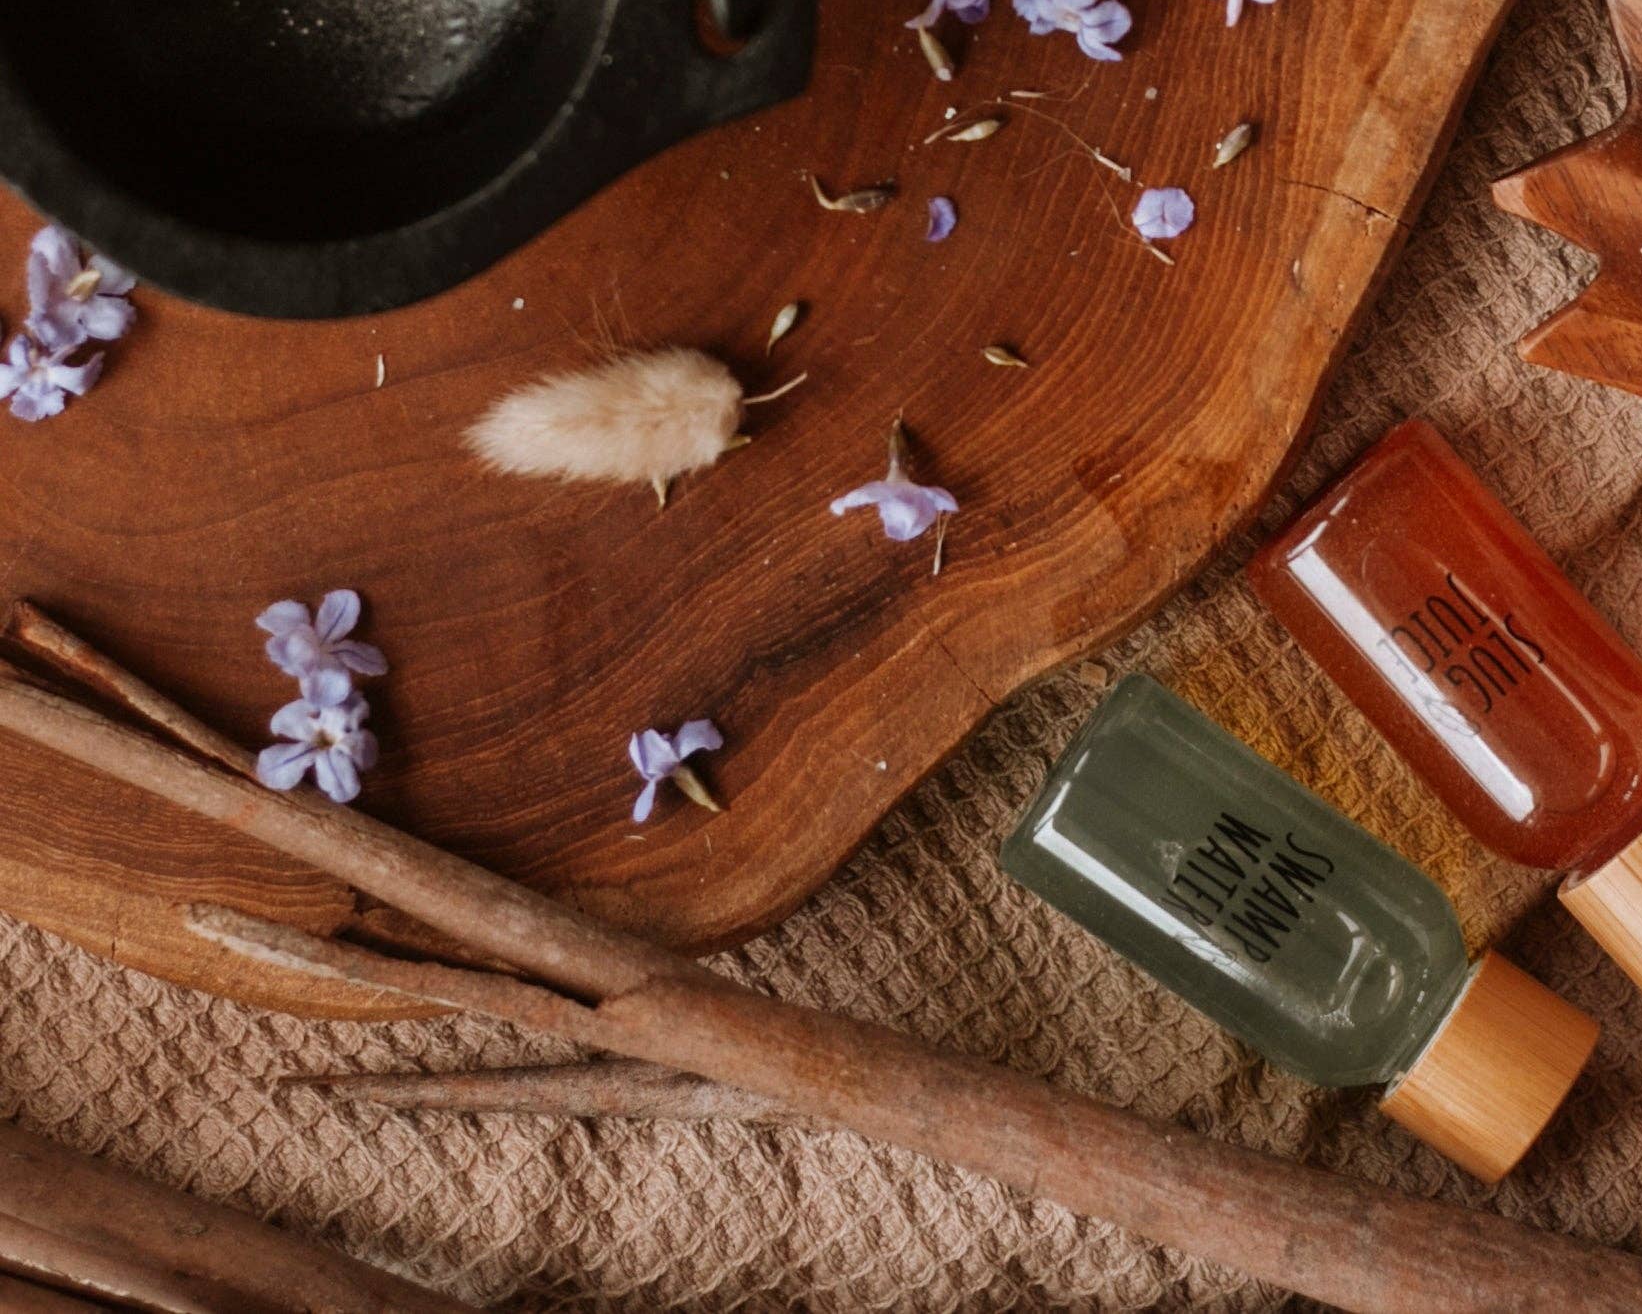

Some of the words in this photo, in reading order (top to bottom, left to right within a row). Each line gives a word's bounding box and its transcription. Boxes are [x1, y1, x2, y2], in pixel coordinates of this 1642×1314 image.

[1376, 572, 1490, 684] JUICE
[1445, 612, 1546, 714] SLUG
[1160, 811, 1272, 927] WATER
[1224, 831, 1335, 963] SWAMP
